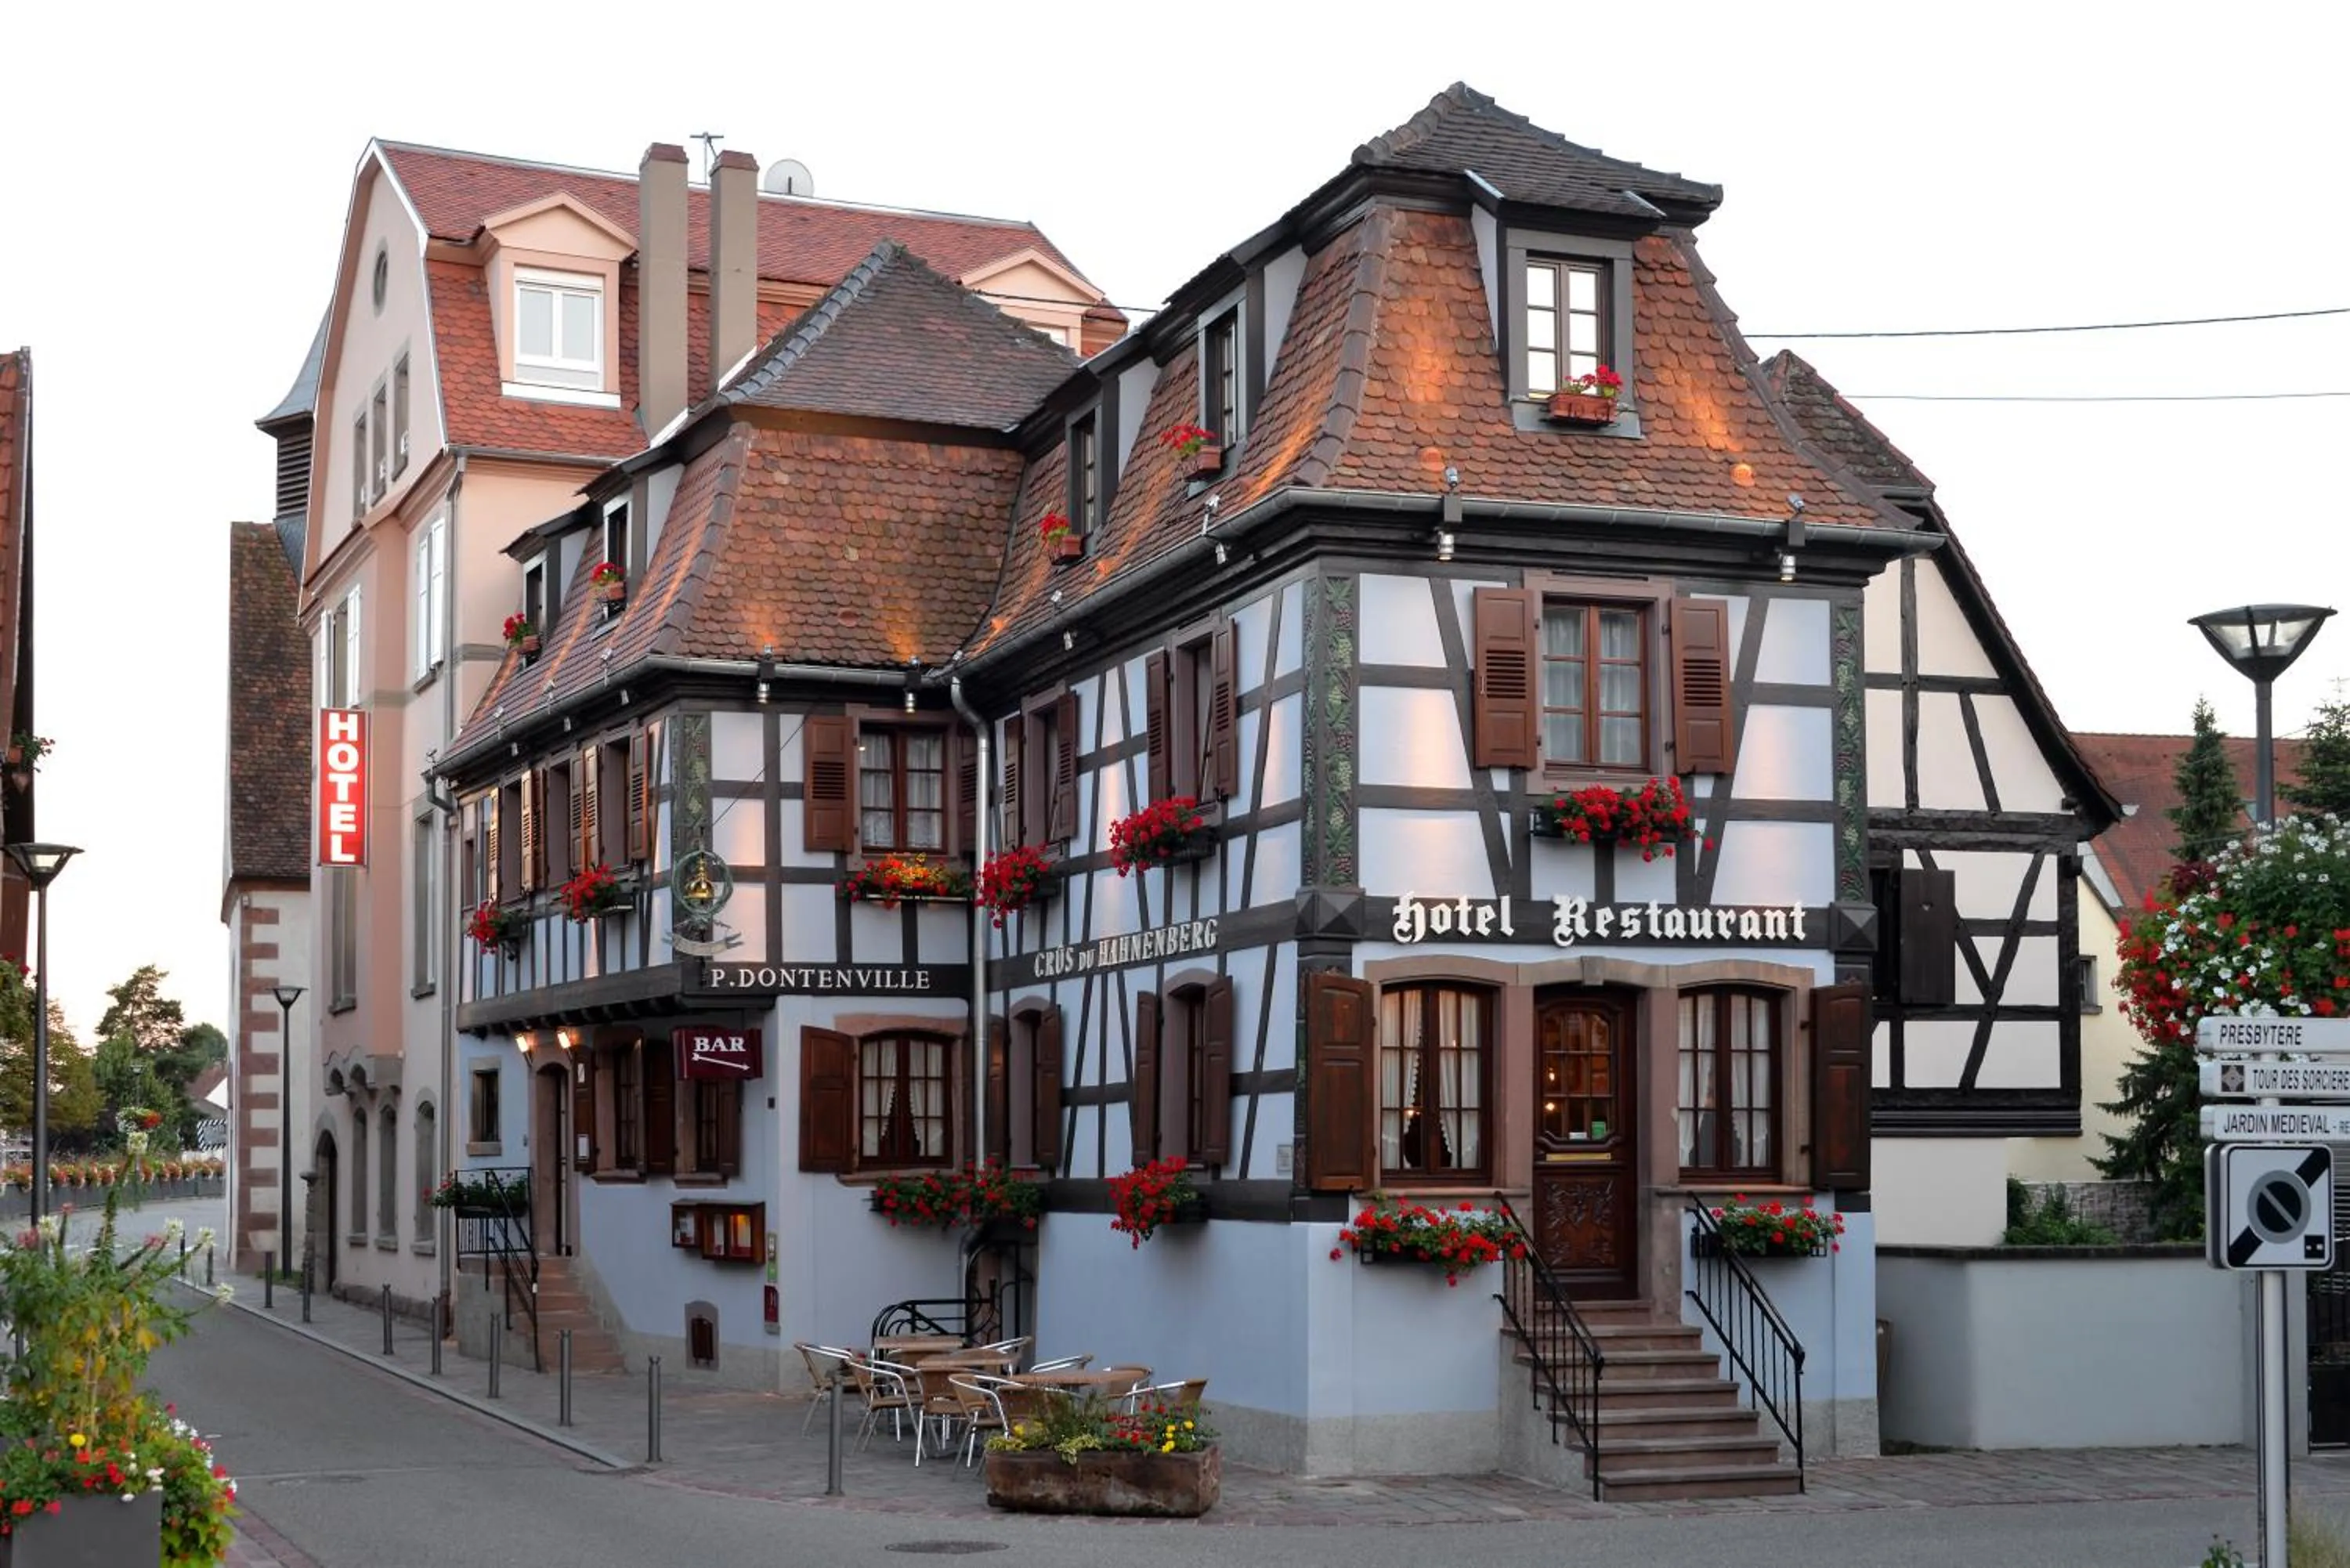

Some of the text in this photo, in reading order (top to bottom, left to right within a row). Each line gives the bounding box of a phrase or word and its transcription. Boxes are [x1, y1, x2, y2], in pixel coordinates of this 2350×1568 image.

[327, 712, 360, 862] HOTEL
[1392, 891, 1806, 947] Hotel Restaurant
[1078, 948, 1095, 972] DU
[1097, 918, 1218, 967] HAHNENBERG
[693, 1036, 747, 1053] BAR
[2220, 1024, 2303, 1046] PRESBYTERE
[2253, 1069, 2279, 1090] TOUR
[2281, 1069, 2299, 1090] DES
[2224, 1113, 2268, 1134] JARDIN
[2272, 1115, 2330, 1134] MEDIEVAL
